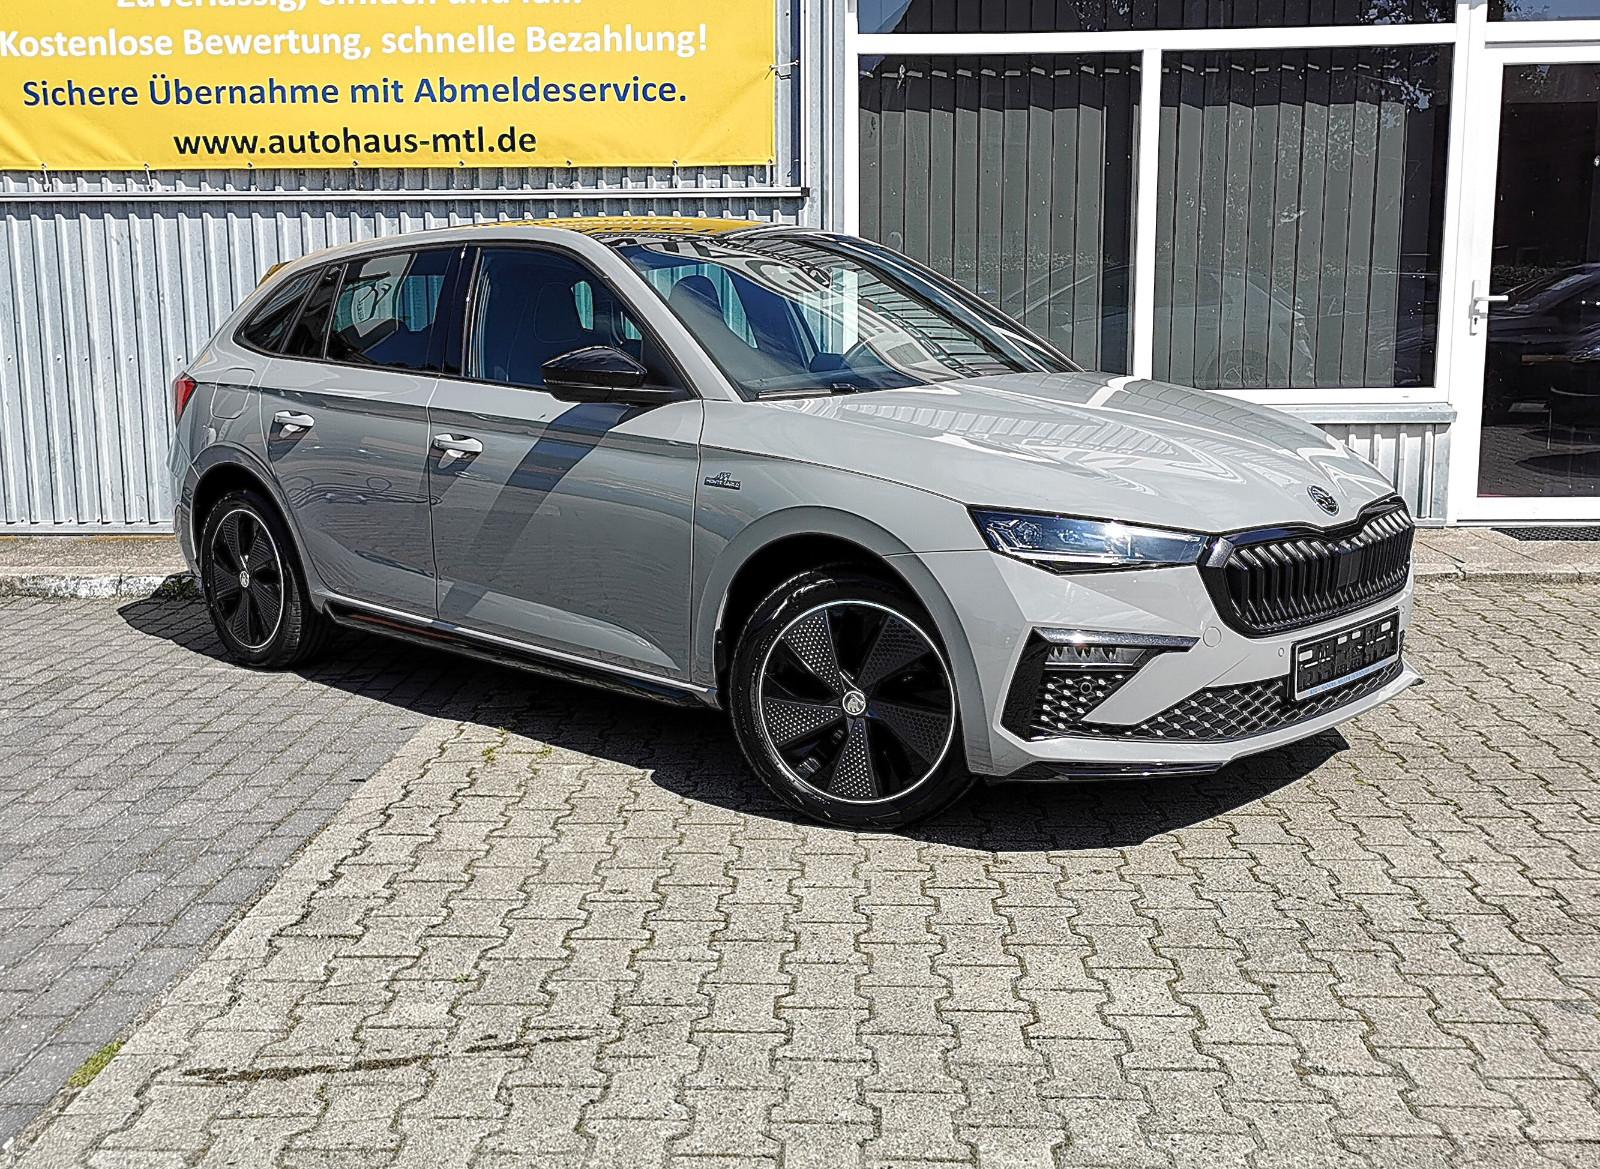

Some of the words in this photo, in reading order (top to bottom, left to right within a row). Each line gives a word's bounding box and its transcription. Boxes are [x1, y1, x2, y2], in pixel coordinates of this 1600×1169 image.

[0, 29, 173, 57] Kostenlose
[183, 29, 372, 60] Bewertung,
[382, 25, 516, 53] schnelle
[526, 24, 707, 58] Bezahlung!
[23, 80, 138, 106] Sichere
[149, 74, 339, 105] Übernahme
[350, 77, 404, 104] mit
[414, 76, 687, 103] Abmeldeservice.
[173, 126, 537, 155] www.autohaus-mtl.de
